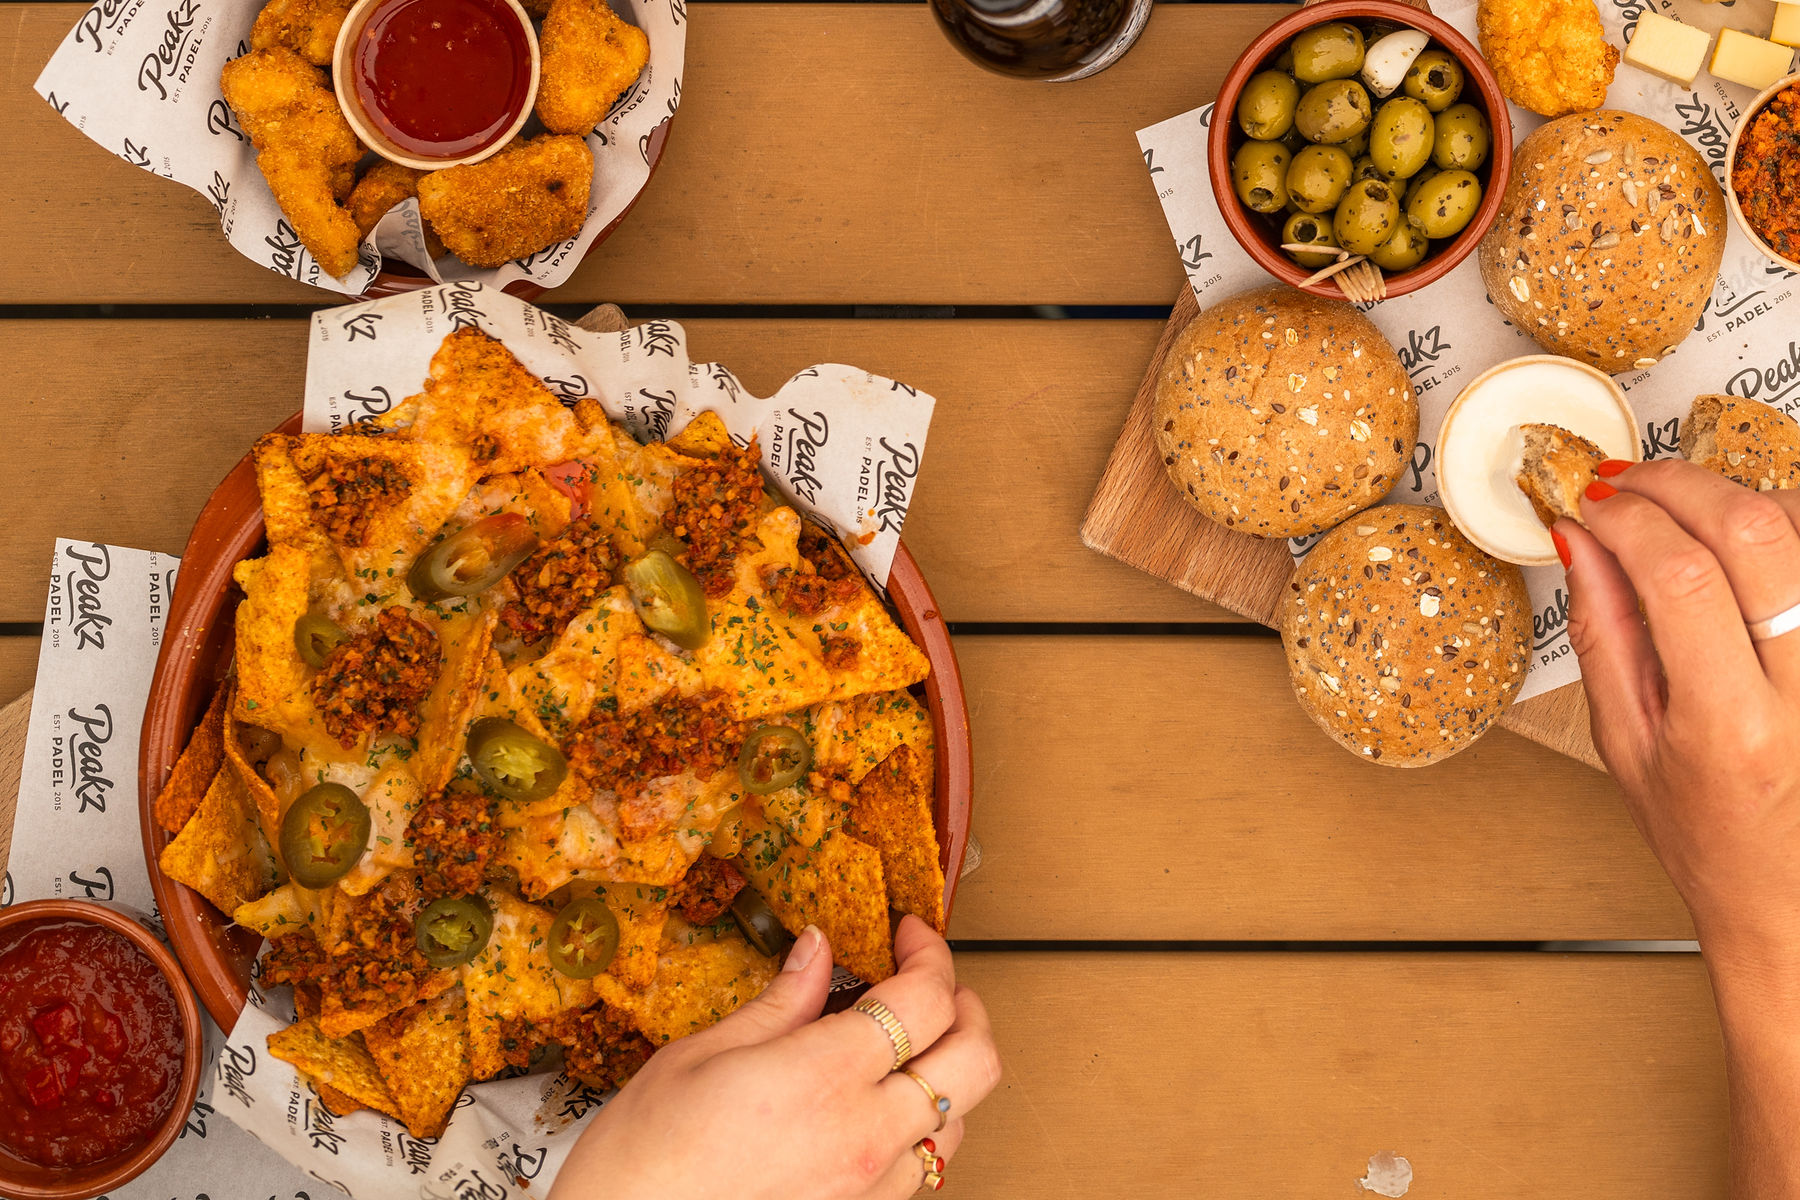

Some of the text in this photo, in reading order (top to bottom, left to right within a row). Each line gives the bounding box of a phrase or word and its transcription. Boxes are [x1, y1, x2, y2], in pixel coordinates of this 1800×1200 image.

[179, 37, 203, 84] PADEL
[612, 88, 649, 125] PADEL
[421, 290, 435, 318] PADEL
[1706, 290, 1793, 344] EST. PADEL 2015
[770, 424, 784, 469] PADEL
[788, 408, 829, 506] Peakz
[856, 457, 872, 502] PADEL
[878, 436, 919, 535] Peakz
[50, 574, 64, 625] PADEL
[66, 543, 112, 650] Peakz
[149, 572, 161, 623] PADEL
[52, 714, 65, 811] EST. PADEL 2015
[68, 703, 114, 813] Peakz
[287, 1090, 301, 1125] PADEL
